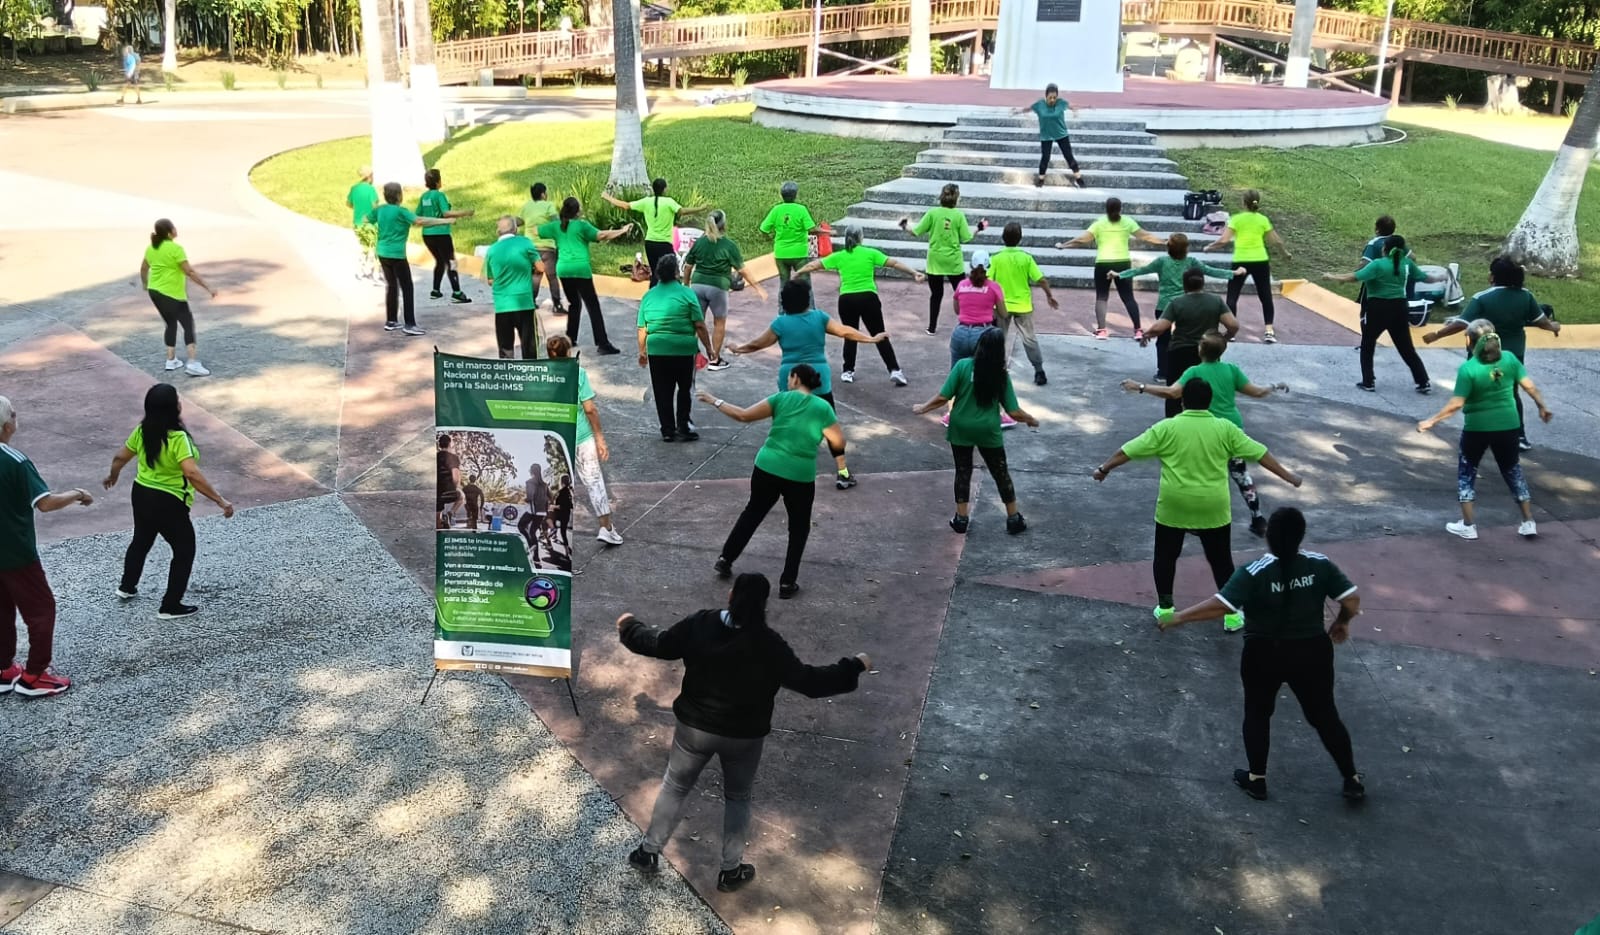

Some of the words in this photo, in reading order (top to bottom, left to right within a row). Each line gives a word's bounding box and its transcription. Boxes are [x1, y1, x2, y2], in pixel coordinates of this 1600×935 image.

[443, 360, 455, 369] En
[456, 361, 464, 369] el
[493, 362, 506, 371] del
[507, 363, 548, 372] Programa
[443, 370, 479, 380] Nacional
[480, 372, 492, 380] de
[493, 372, 540, 382] Activación
[443, 382, 463, 390] para
[464, 381, 473, 389] la
[474, 381, 524, 391] Salud-IMSS
[444, 570, 480, 578] Programa
[444, 579, 493, 587] Personalizado
[494, 580, 504, 588] de
[444, 587, 474, 595] Ejercicio
[461, 595, 468, 603] la
[468, 595, 490, 604] Salud.
